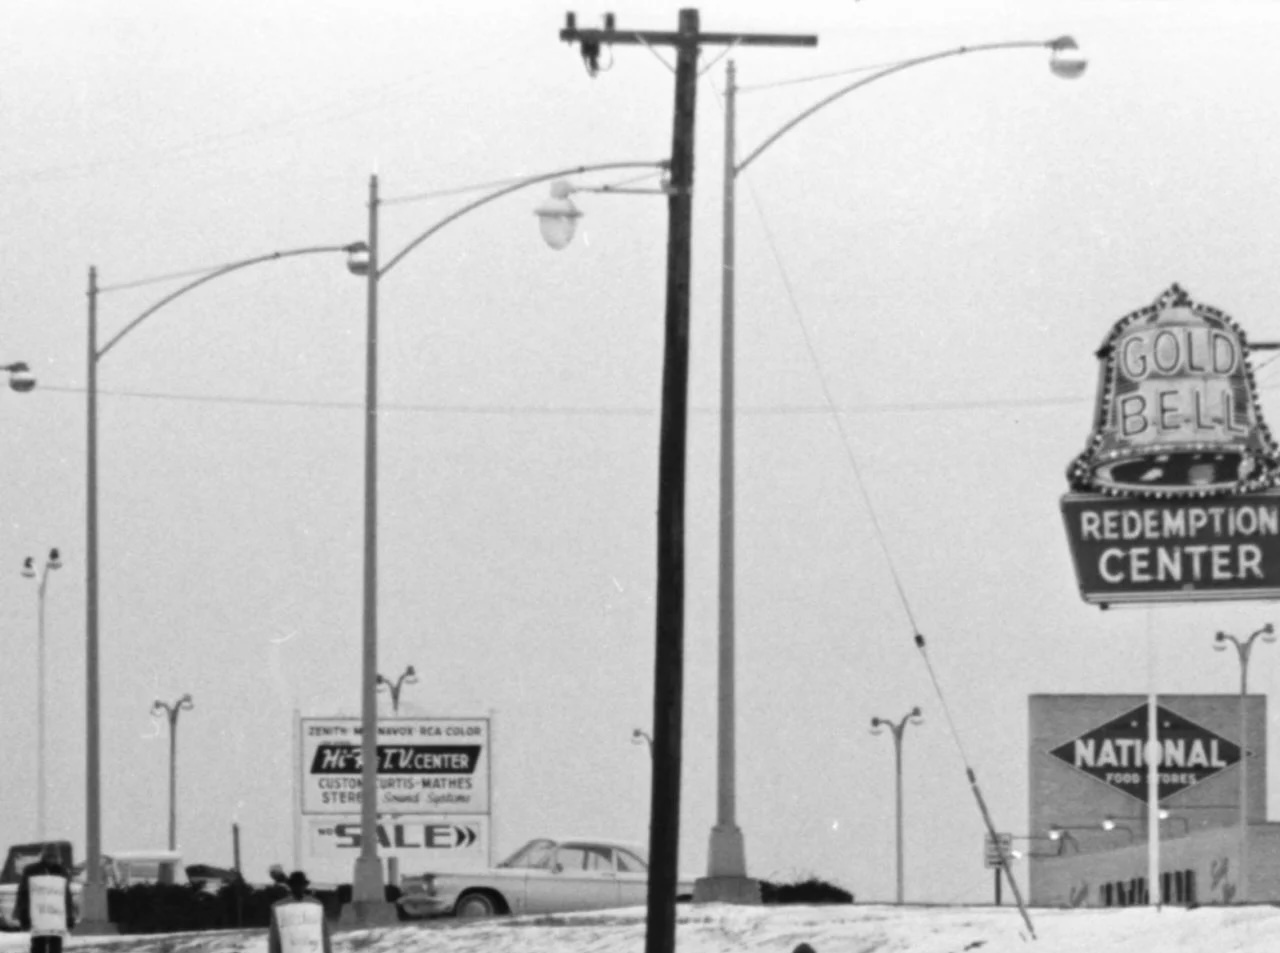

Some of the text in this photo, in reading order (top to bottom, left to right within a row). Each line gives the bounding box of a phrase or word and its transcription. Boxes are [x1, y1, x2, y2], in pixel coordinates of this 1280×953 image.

[1121, 328, 1237, 382] GOLD
[1118, 388, 1246, 438] BELL
[1080, 505, 1280, 541] REDEMPTION
[1098, 544, 1265, 583] CENTER
[415, 754, 470, 770] CENTER
[1073, 738, 1228, 768] NATIONAL
